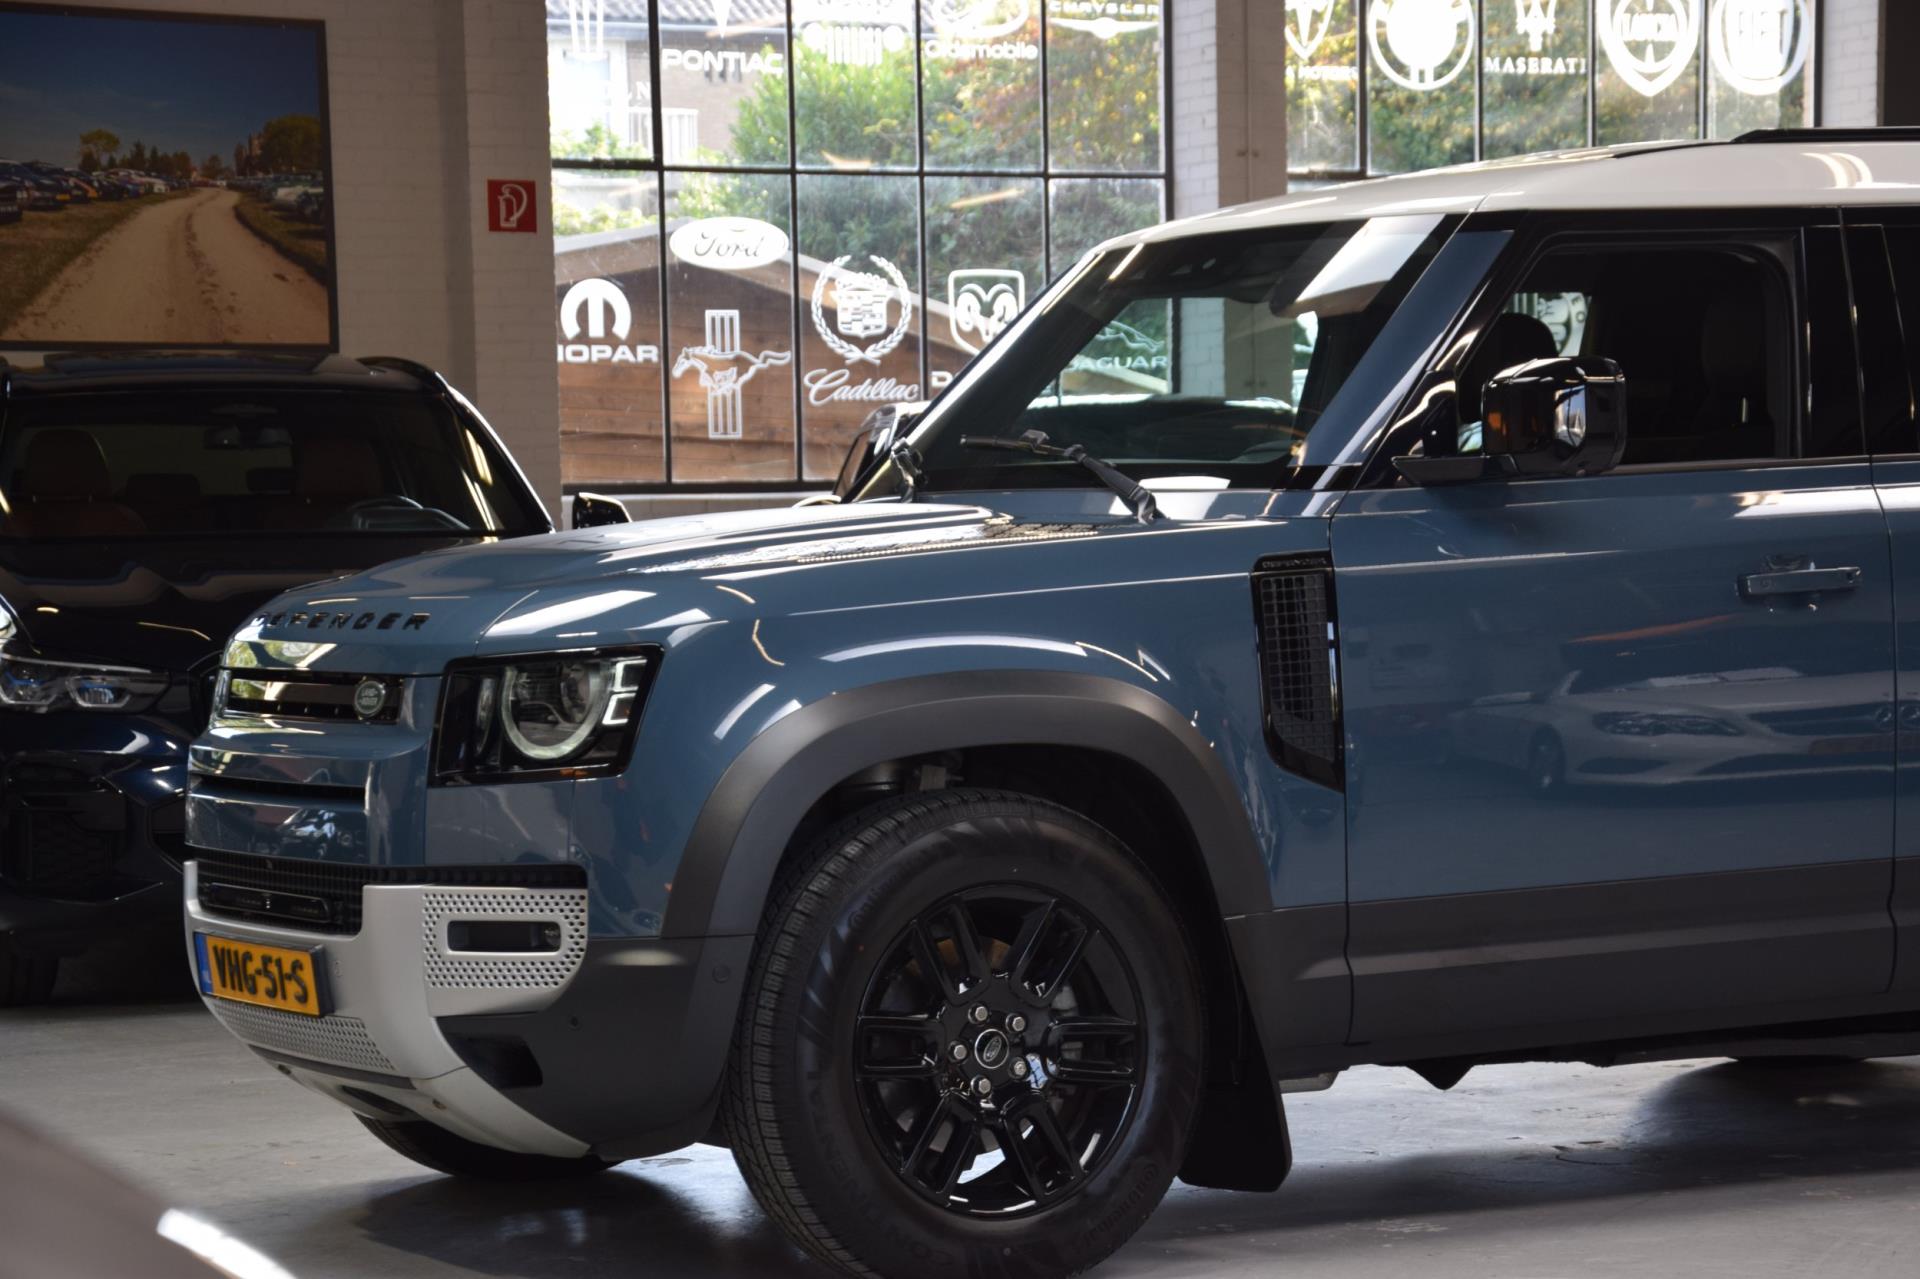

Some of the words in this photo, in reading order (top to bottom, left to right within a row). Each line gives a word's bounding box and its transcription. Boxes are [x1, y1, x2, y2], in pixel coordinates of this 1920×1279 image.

[660, 48, 784, 74] PONTIAC
[1484, 56, 1588, 75] MASERATI
[693, 230, 765, 258] Ford
[1070, 354, 1168, 370] JAGUAR
[803, 368, 920, 407] Cadillac
[212, 943, 309, 1004] VHG-51-S
